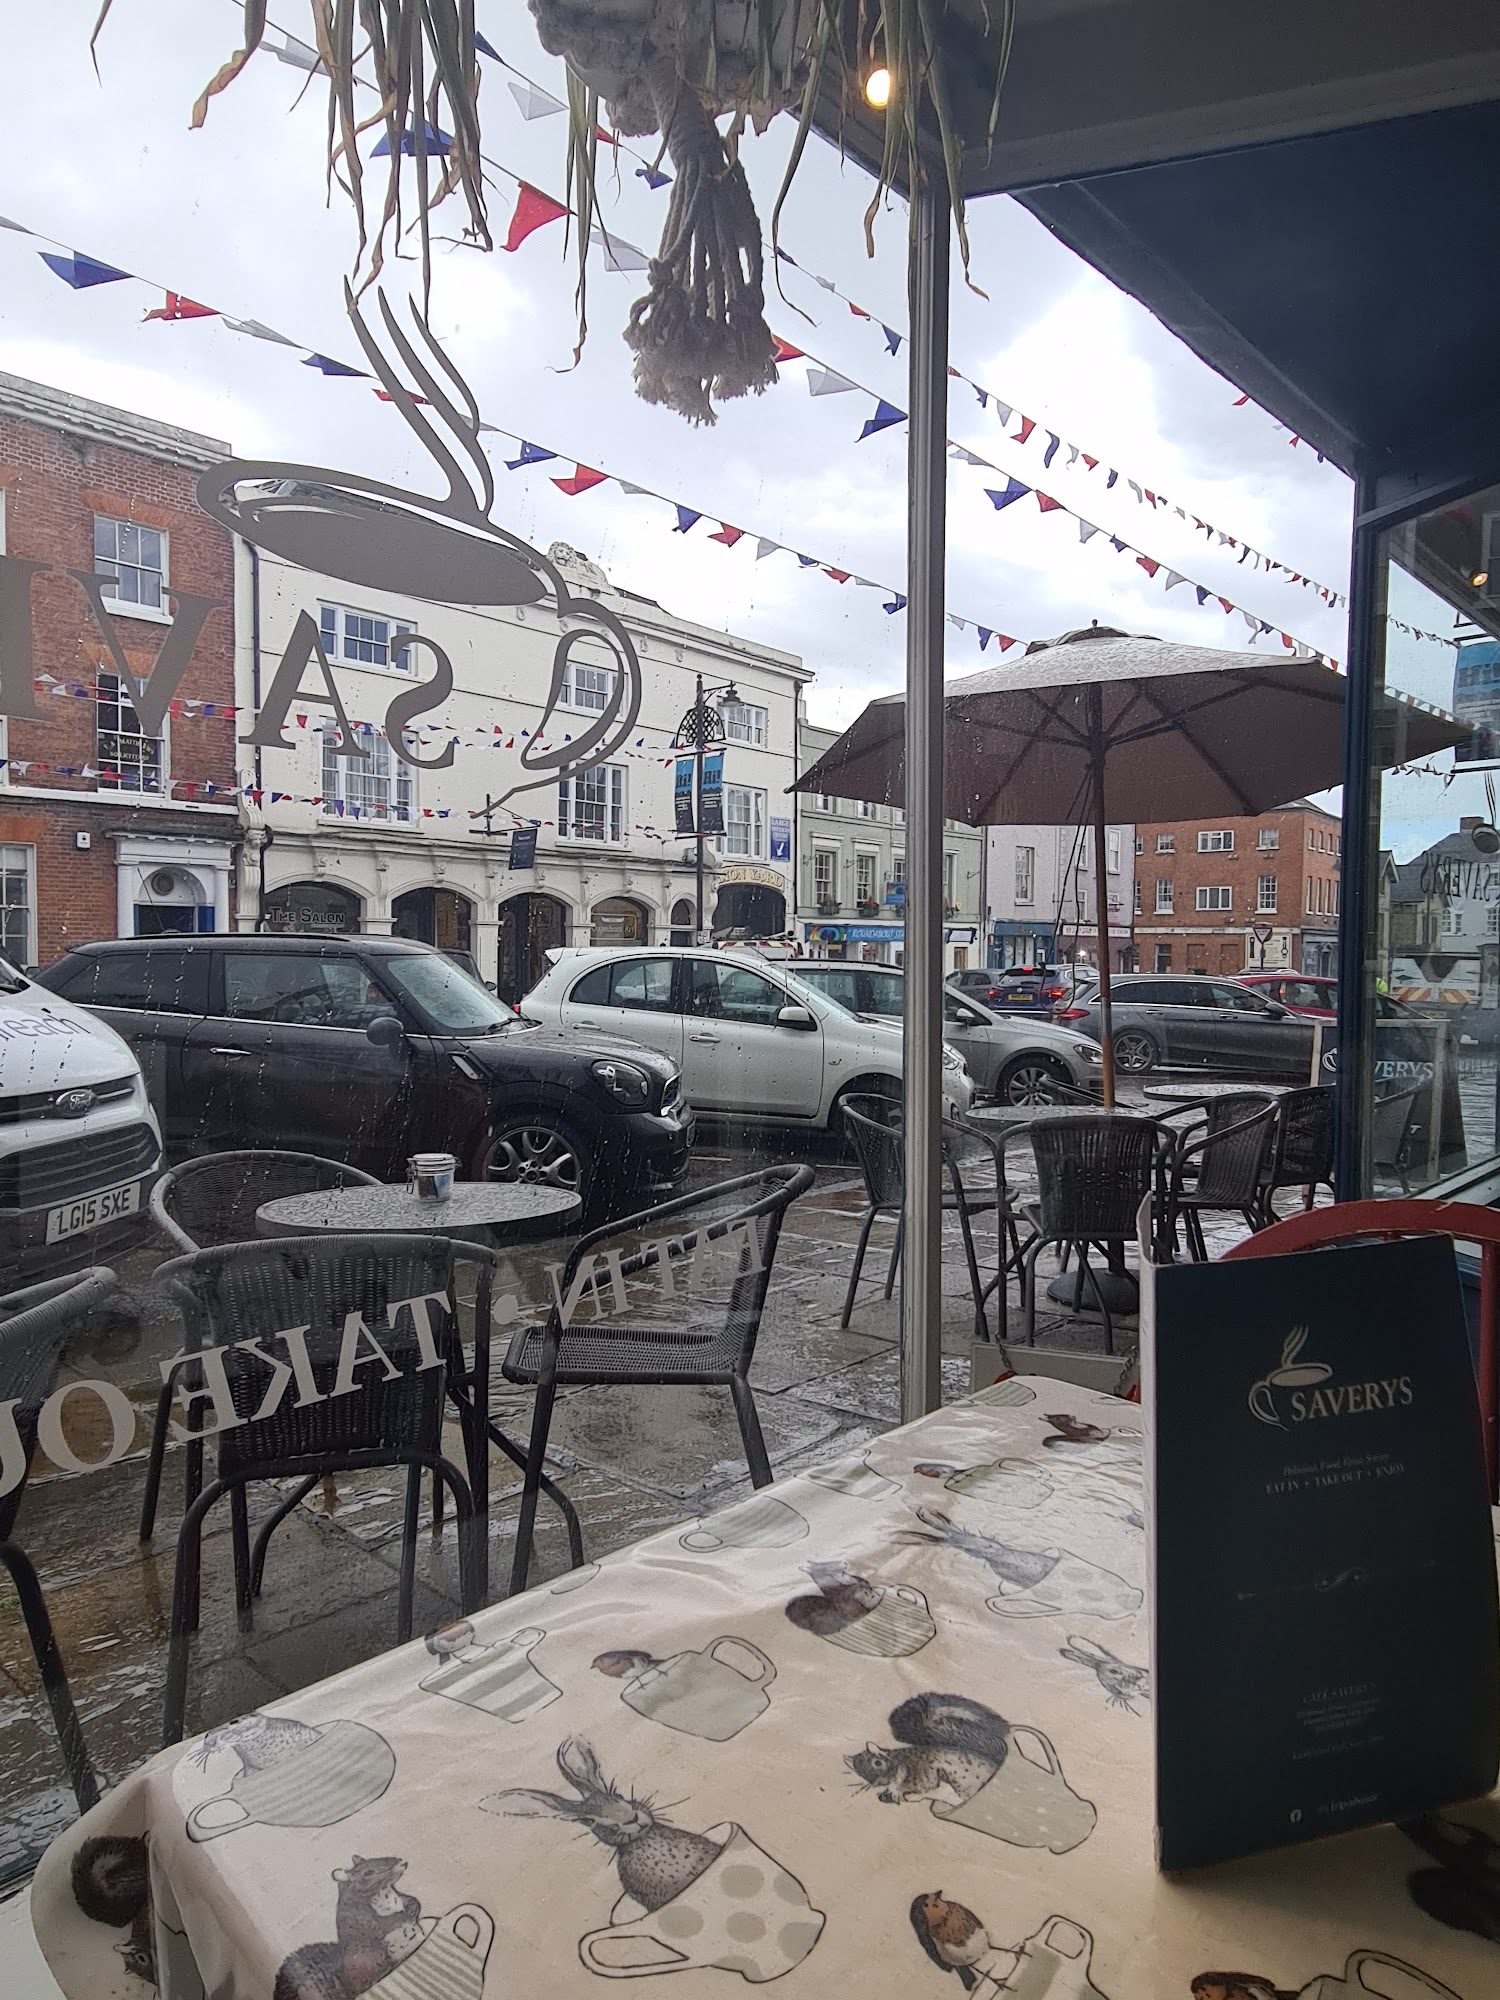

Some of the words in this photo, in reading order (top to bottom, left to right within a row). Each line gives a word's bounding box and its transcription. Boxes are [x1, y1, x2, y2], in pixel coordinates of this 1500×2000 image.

[269, 906, 297, 923] THE
[301, 907, 346, 924] SALON
[852, 928, 894, 940] ROUNDABOUT
[58, 1199, 96, 1235] LG15
[99, 1188, 131, 1220] SXE
[1291, 1376, 1413, 1422] SAVERYS
